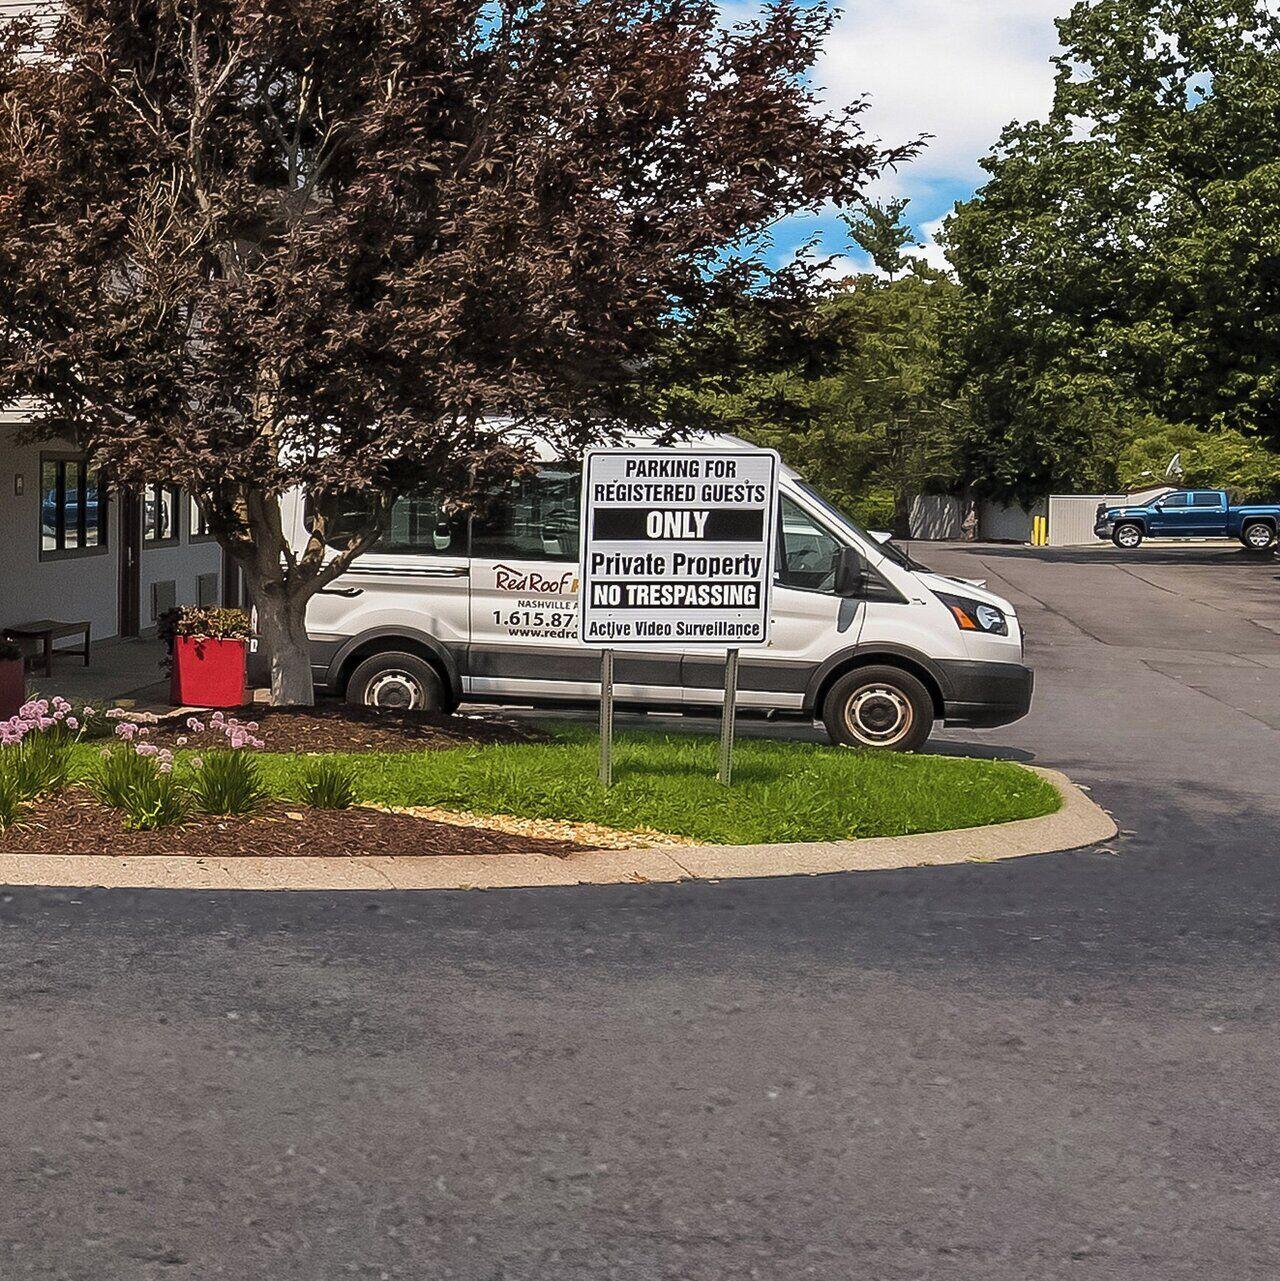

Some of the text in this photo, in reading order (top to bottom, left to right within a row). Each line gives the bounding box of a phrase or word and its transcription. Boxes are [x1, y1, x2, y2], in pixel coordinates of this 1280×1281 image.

[625, 459, 736, 478] PARKING FOR
[594, 484, 765, 503] REGISTERED GUESTS
[646, 511, 710, 539] ONLY
[591, 553, 762, 578] Private Property
[593, 584, 621, 606] NO
[626, 584, 757, 606] TRESPASSING
[518, 600, 570, 610] NASHVILLE
[493, 611, 578, 629] 1.615.87
[589, 621, 760, 637] Active Video Surveillance
